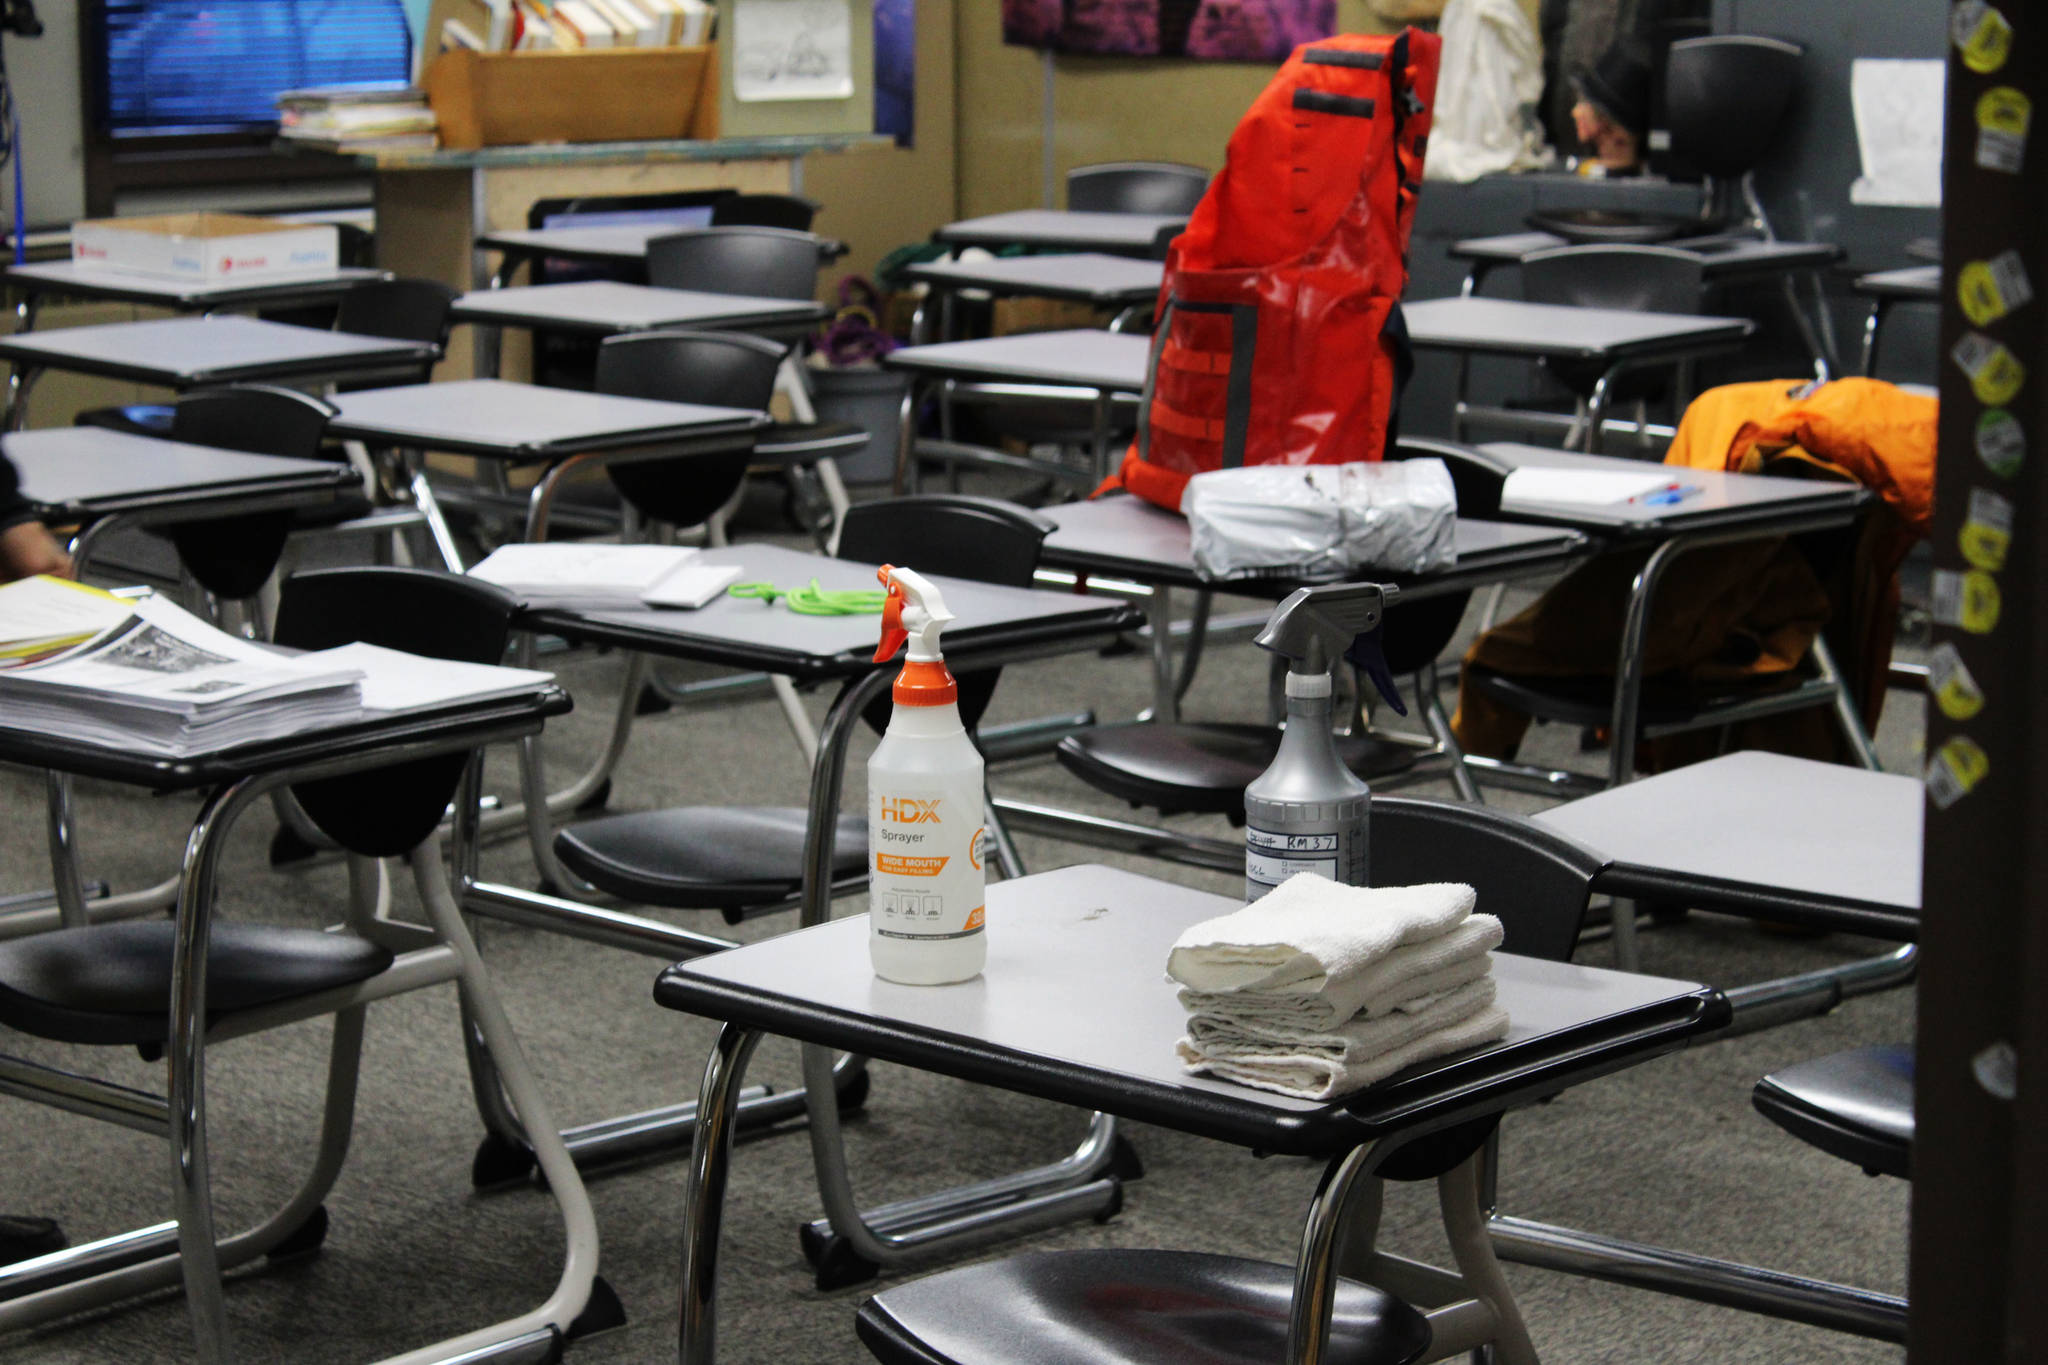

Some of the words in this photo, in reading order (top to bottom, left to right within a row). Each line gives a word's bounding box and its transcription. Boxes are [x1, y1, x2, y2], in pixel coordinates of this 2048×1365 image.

[881, 796, 942, 824] HDX
[881, 829, 925, 843] Sprayer
[882, 855, 904, 866] WIDE
[905, 857, 942, 868] MOUTH
